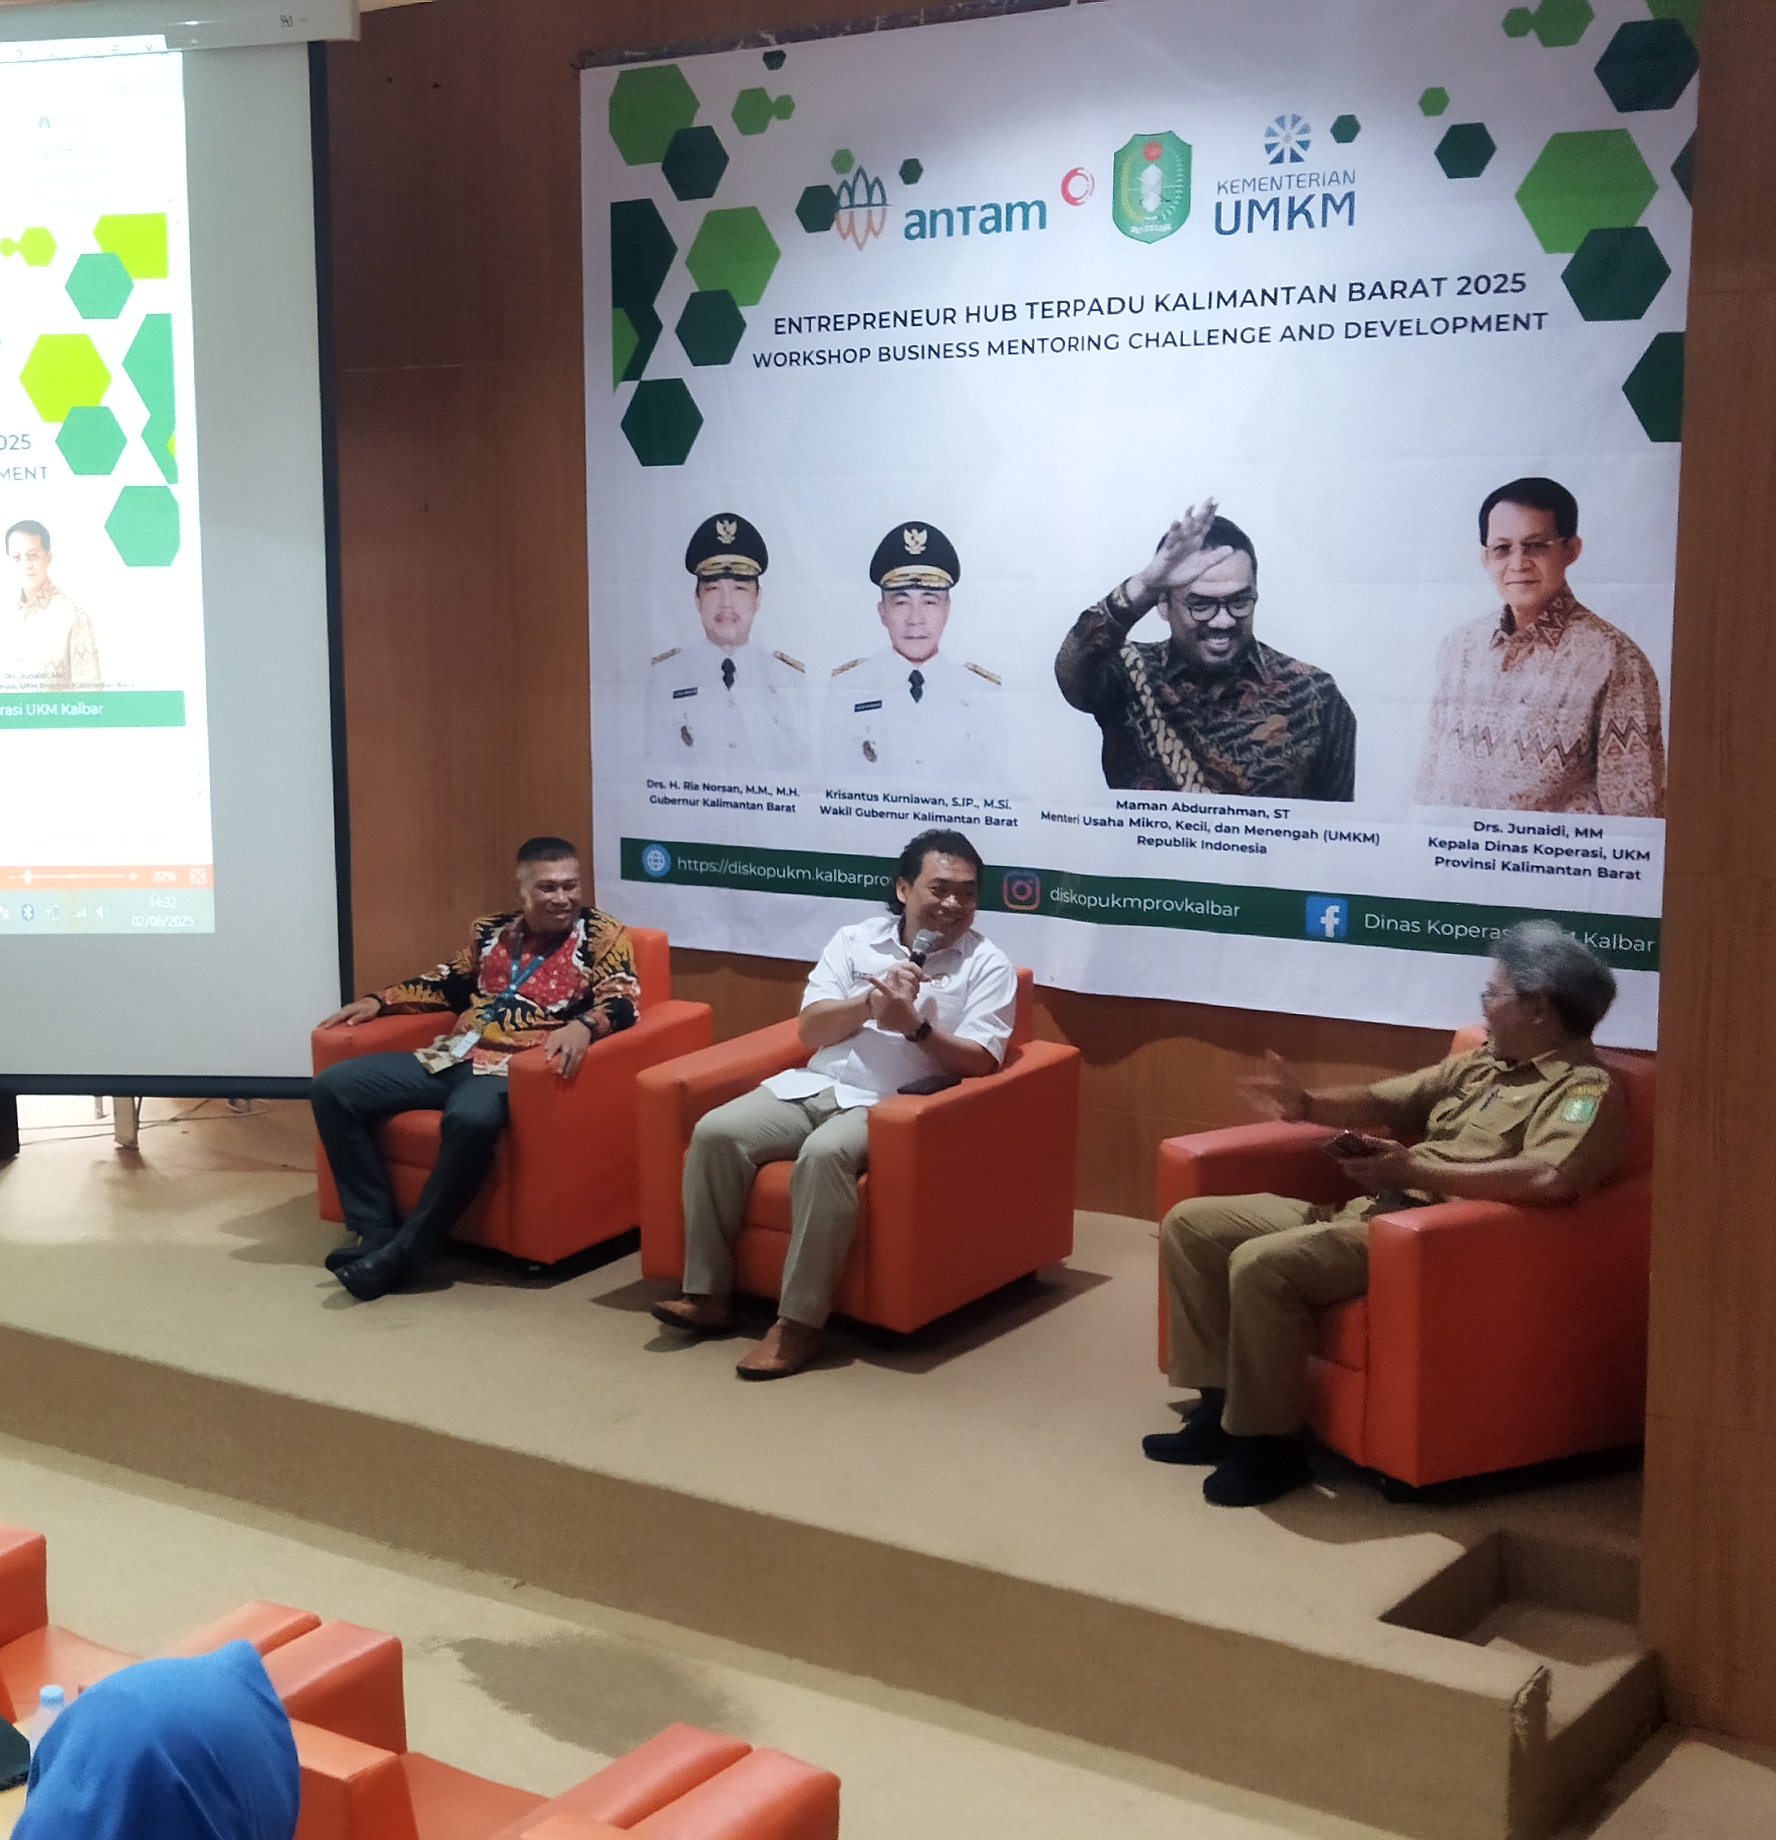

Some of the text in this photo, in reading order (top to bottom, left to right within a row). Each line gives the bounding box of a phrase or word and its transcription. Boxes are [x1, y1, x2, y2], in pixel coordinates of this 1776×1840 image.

[1217, 169, 1356, 195] KEMENTERIAN
[1215, 190, 1356, 236] UMKM
[773, 272, 1527, 336] ENTREPRENEUR HUB TERPADU KALIMANTAN BARAT 2025
[753, 311, 1550, 369] WORKSHOP BUSINESS MENTORING CHALLENGE AND DEVELOPMENT
[26, 703, 59, 717] UKM
[61, 702, 104, 716] Kalbar
[646, 779, 666, 790] Drs.
[669, 781, 680, 790] H.
[683, 781, 700, 791] Ria
[702, 783, 743, 794] Norsan,
[776, 787, 800, 797] M.H.
[825, 789, 879, 801] Krisantus
[882, 793, 949, 807] Kurniawan,
[983, 799, 1012, 810] M.Si.
[649, 795, 796, 813] Gubernur Kalimantan Barat
[819, 805, 1019, 827] Wakil Gubernur Kalimantan Barat
[1115, 800, 1291, 819] Maman Abdurrahman, ST
[1040, 810, 1380, 846] Menteri Usaha Mikro, Kecil, dan Menengah (UMKM)
[1473, 820, 1604, 839] Drs. Junaidi, MM
[1137, 835, 1268, 855] Republik Indonesia
[1428, 837, 1651, 862] Kepala Dinas Koperasi, UKM
[677, 857, 893, 888] https://diskopukm.kalbarpro
[1434, 856, 1642, 881] Provinsi Kalimantan Barat
[1049, 886, 1241, 918] diskopukmprovkalbar
[1364, 912, 1422, 934] Dinas
[1427, 919, 1509, 940] Koperas
[1583, 931, 1655, 952] Kalbar
